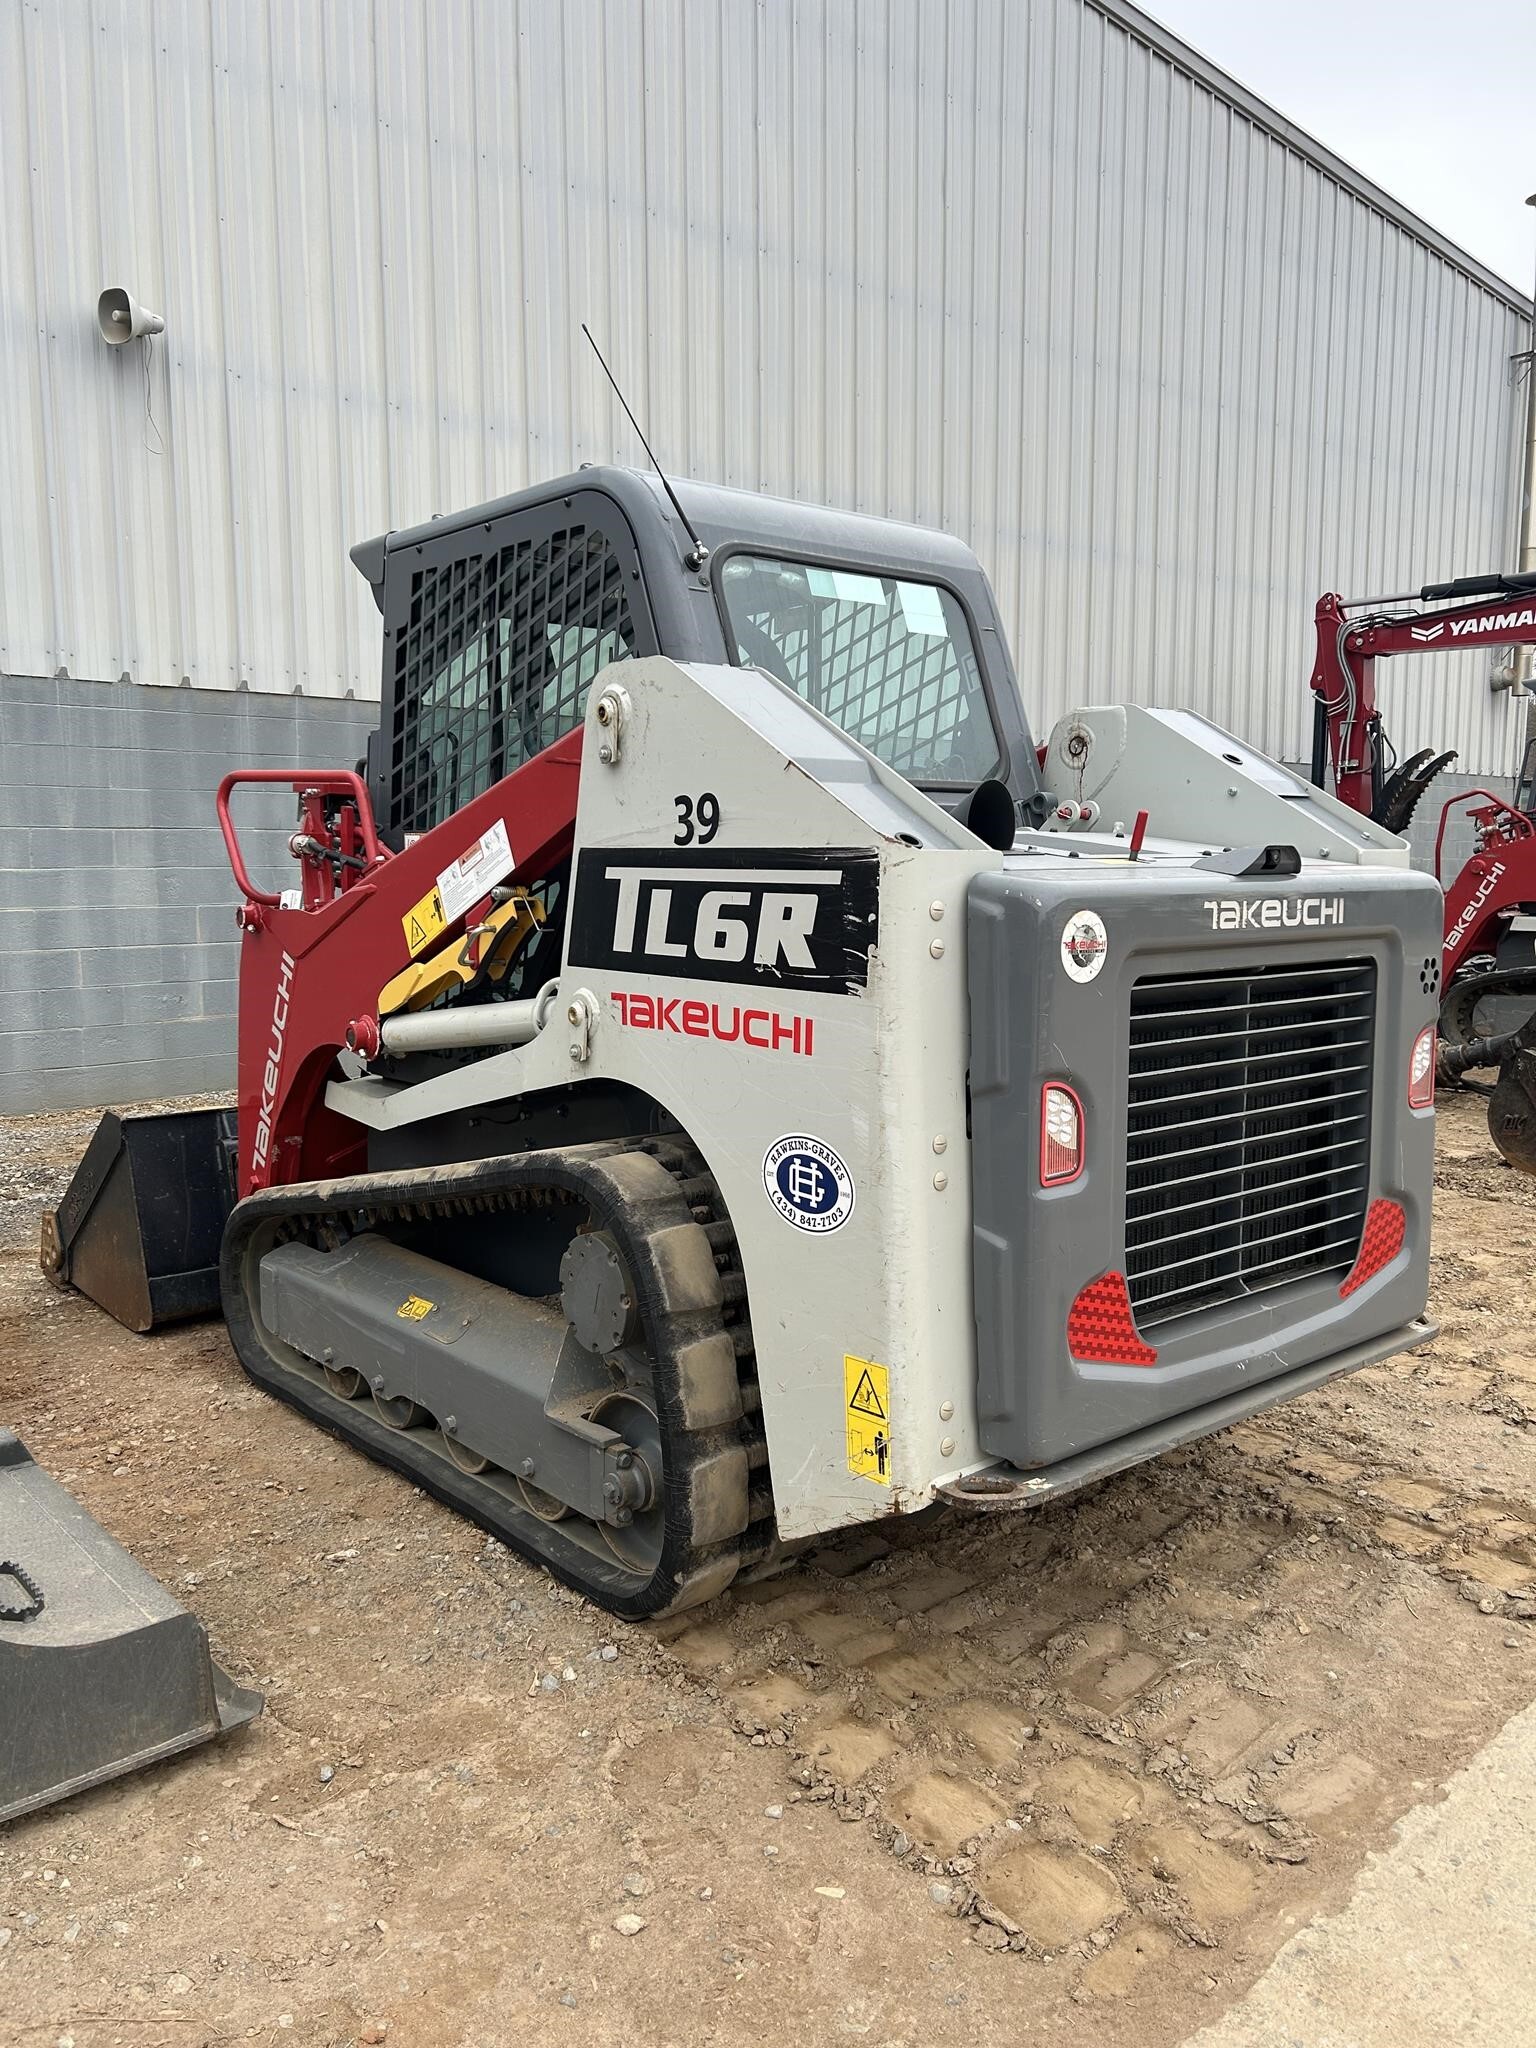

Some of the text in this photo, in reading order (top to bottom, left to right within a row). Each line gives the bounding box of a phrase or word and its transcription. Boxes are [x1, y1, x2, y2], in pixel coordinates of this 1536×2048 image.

[1449, 609, 1536, 636] YANMA
[673, 792, 721, 846] 39
[605, 867, 843, 969] TL6R
[1203, 898, 1344, 930] TAKEUCHI
[1442, 862, 1506, 951] TAKEUCHI
[610, 992, 814, 1056] TAKEUCHI
[252, 950, 296, 1171] TAKEUCHI
[770, 1140, 846, 1181] HAWKINS-GRAVES
[772, 1190, 844, 1227] (434) 847-7703
